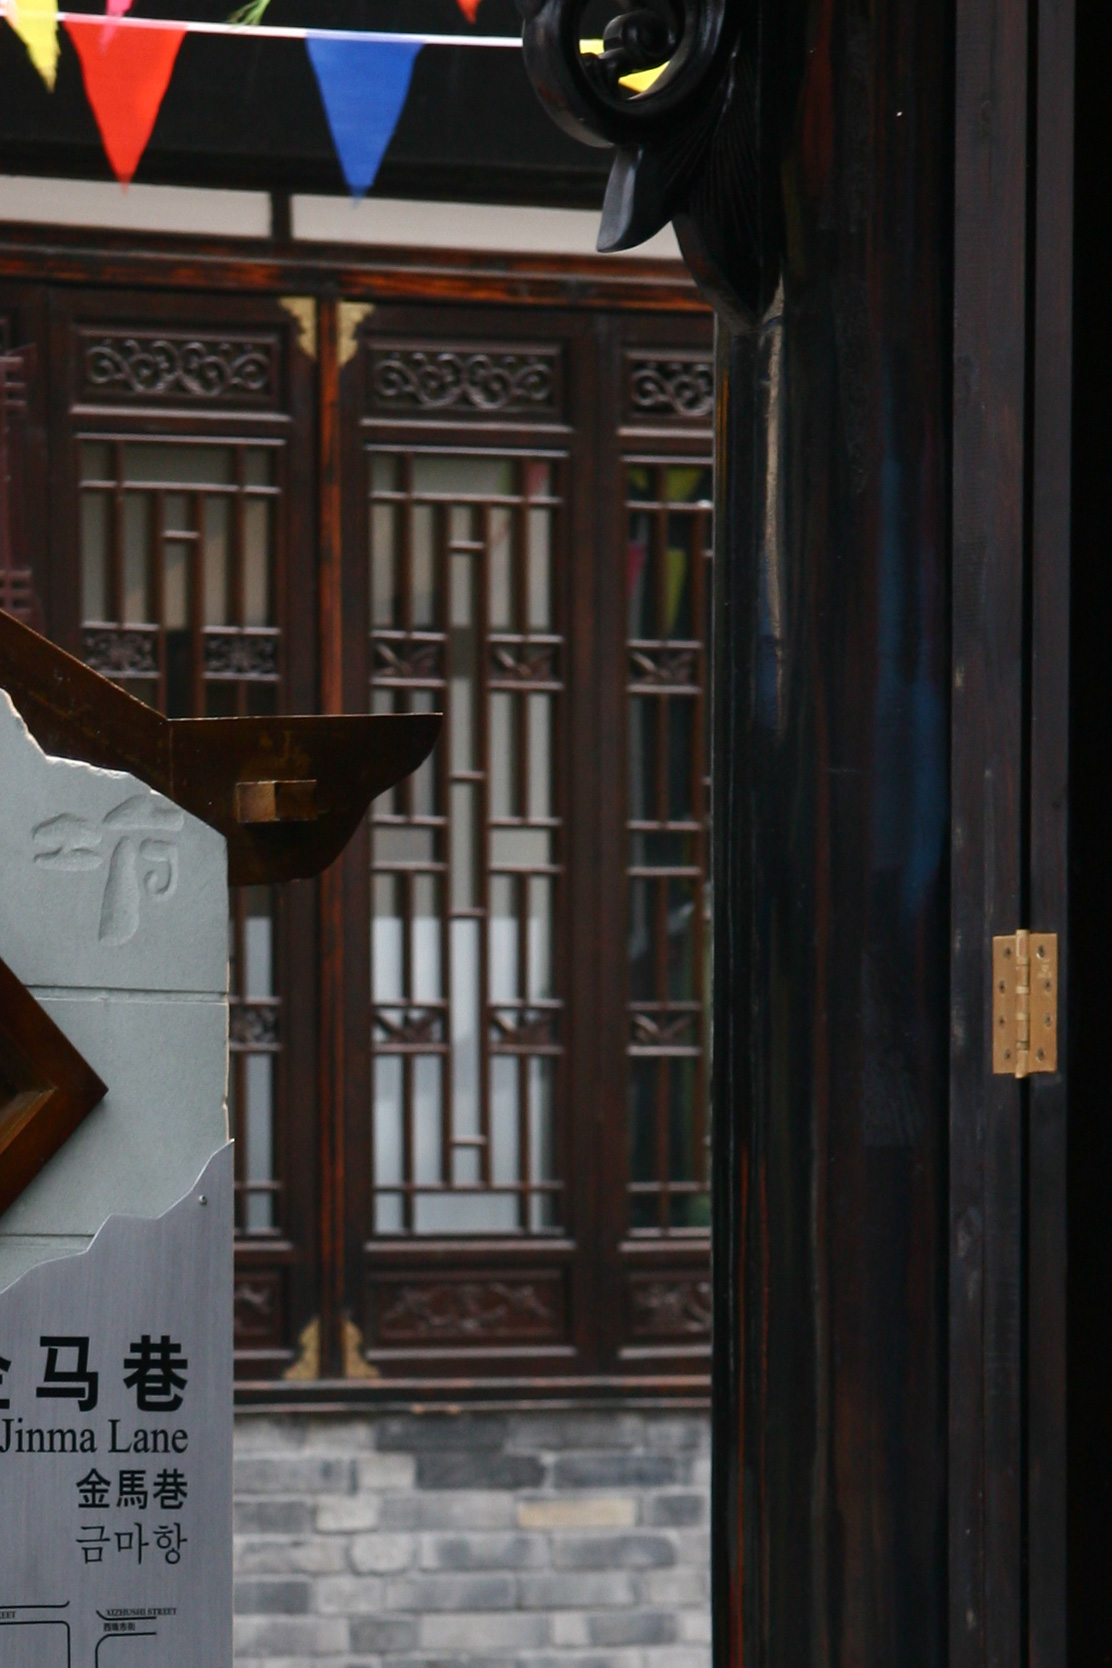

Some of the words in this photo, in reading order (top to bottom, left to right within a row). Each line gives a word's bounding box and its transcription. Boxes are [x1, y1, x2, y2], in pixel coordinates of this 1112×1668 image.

[107, 1419, 188, 1453] Lane
[76, 1468, 187, 1510] 金馬巷
[76, 1522, 187, 1564] 금마항
